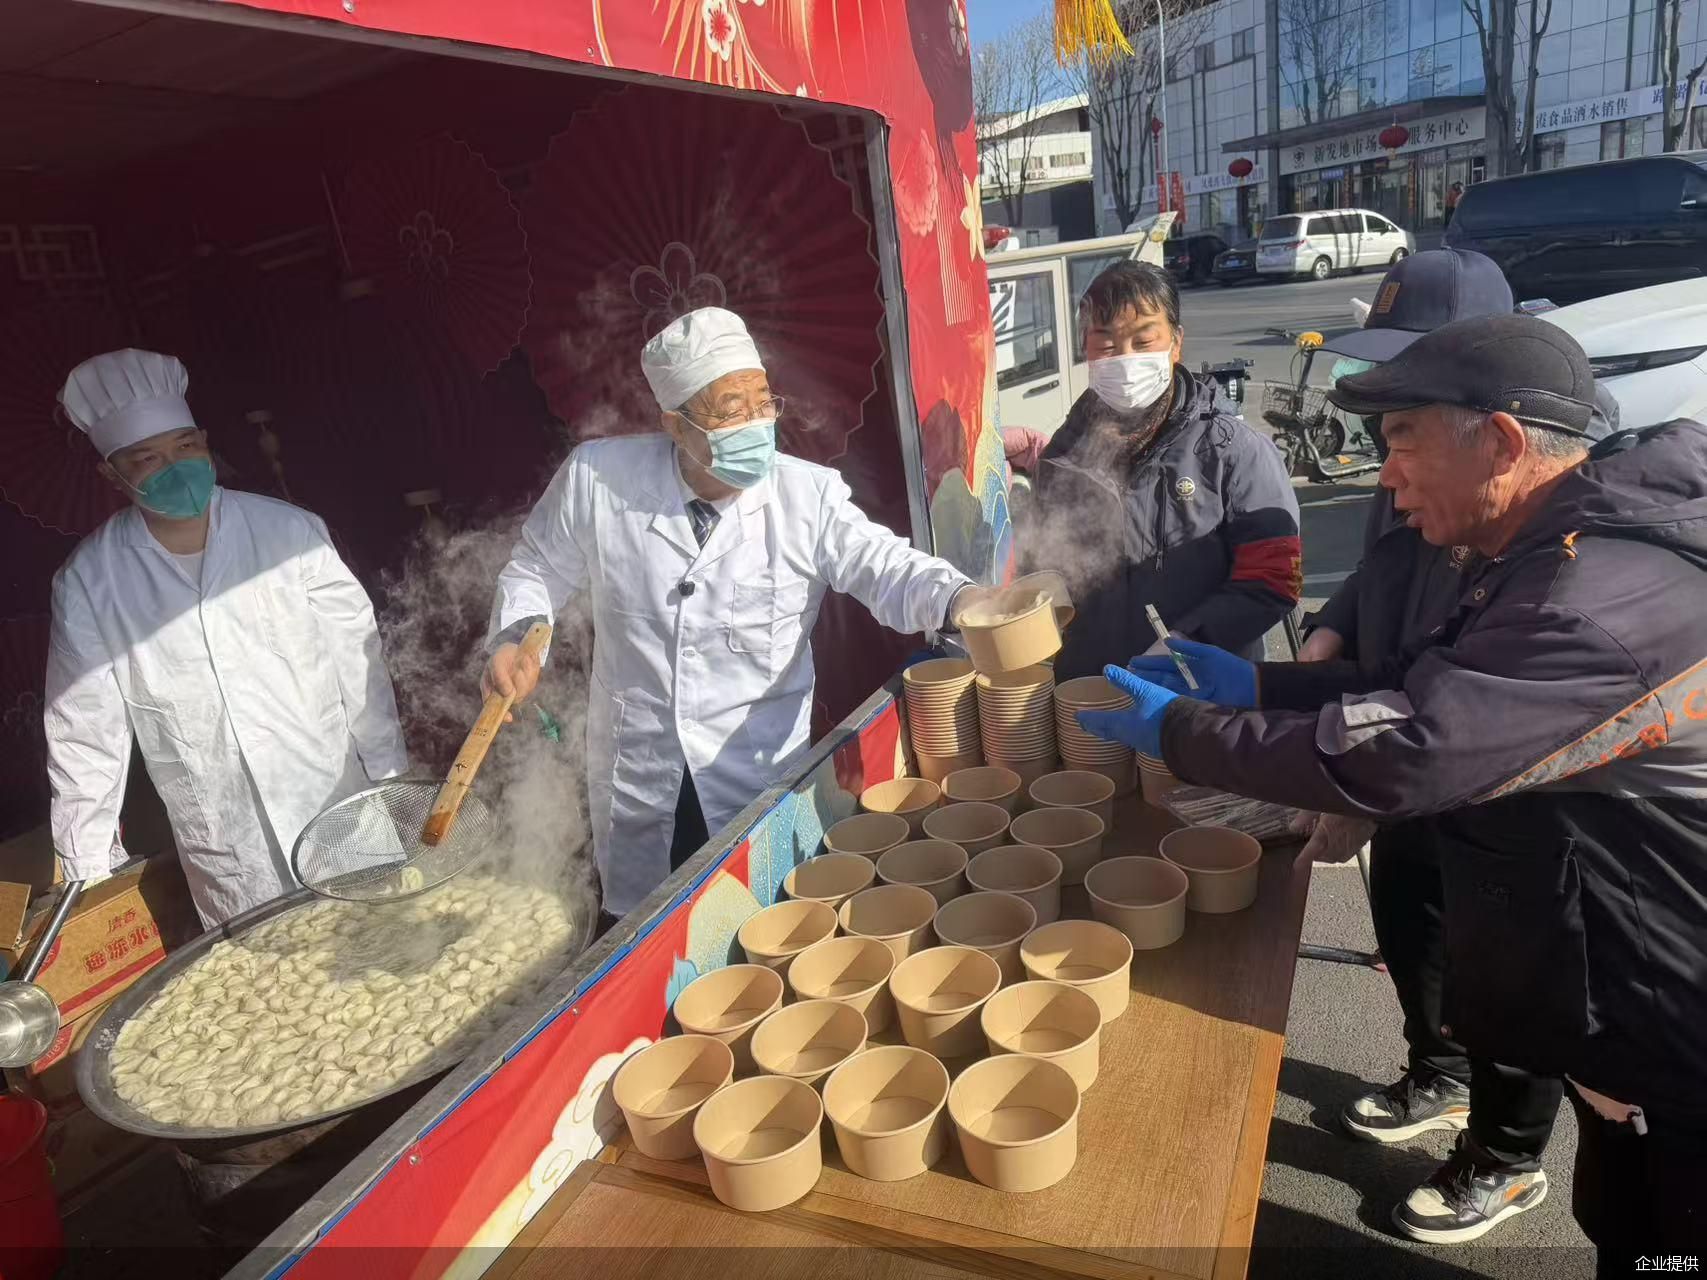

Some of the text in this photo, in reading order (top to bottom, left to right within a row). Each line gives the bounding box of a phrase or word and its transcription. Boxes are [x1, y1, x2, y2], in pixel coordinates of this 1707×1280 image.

[1516, 97, 1629, 132] 霞食品酒水销售
[1313, 117, 1470, 164] 新发地市场服务中心
